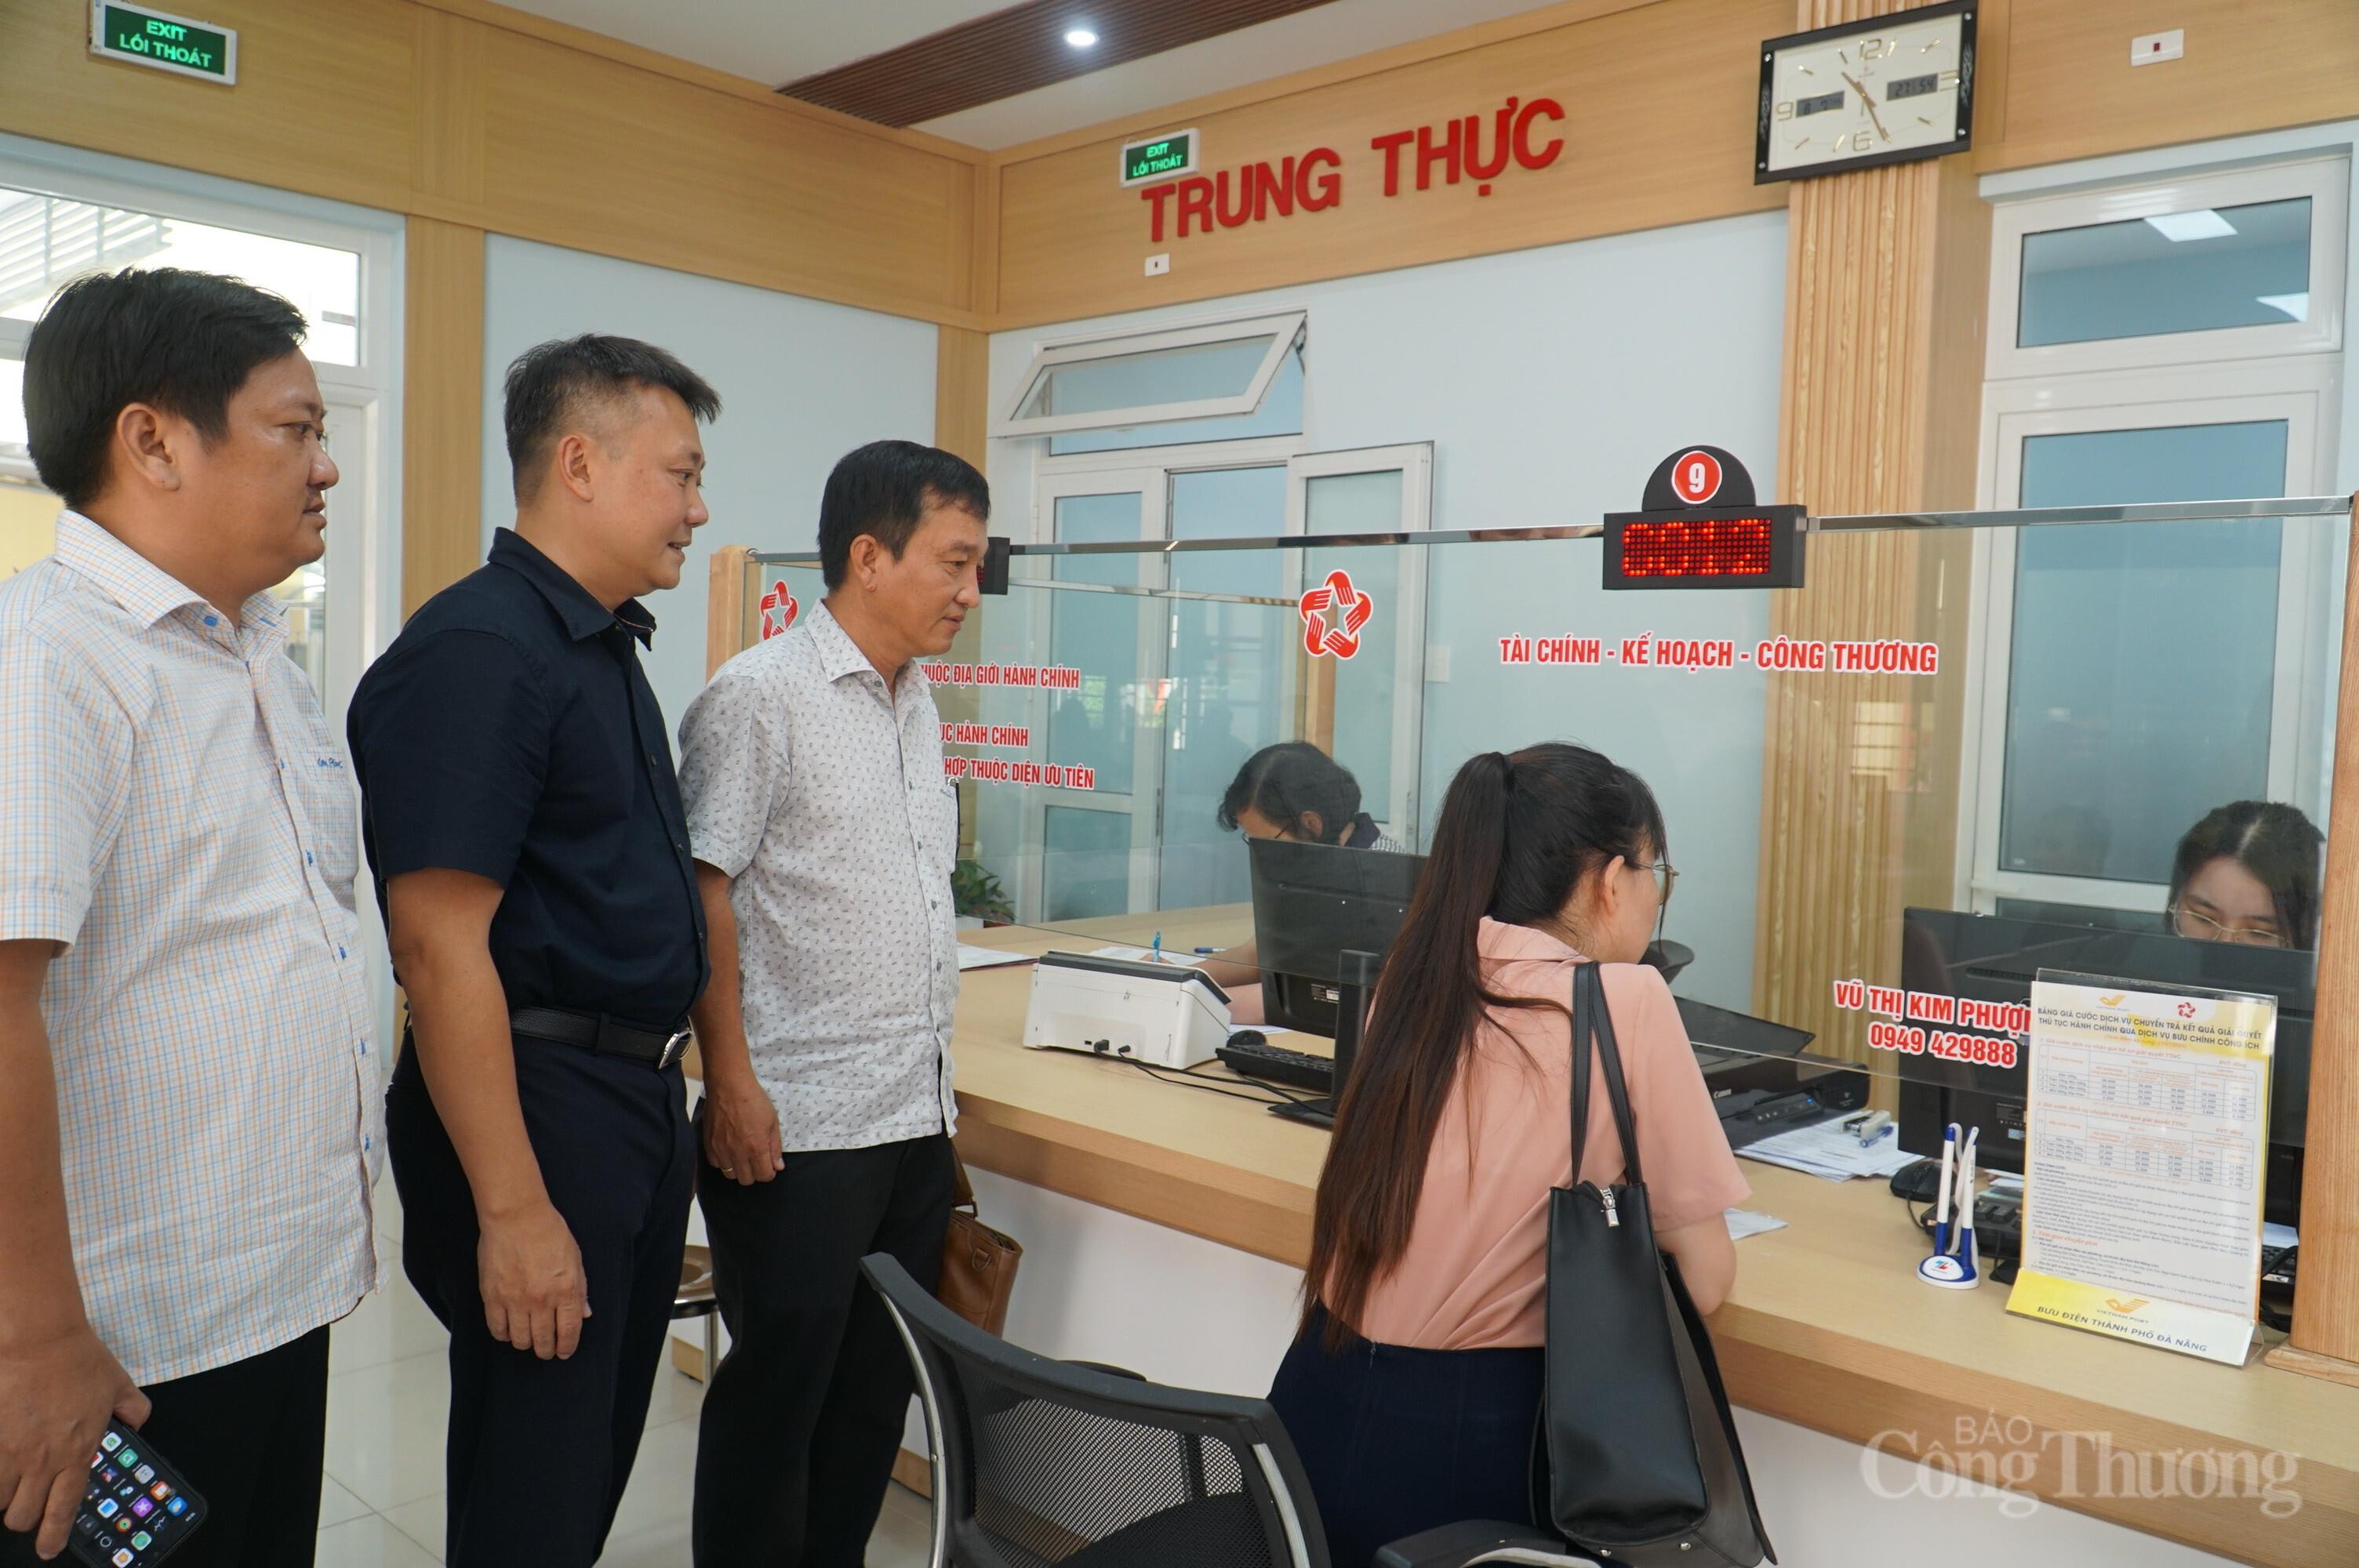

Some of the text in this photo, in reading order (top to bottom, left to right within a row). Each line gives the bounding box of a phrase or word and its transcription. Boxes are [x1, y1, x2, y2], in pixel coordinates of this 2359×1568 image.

[146, 20, 187, 42] EXIT
[119, 32, 212, 67] LỐI THOÁT
[1859, 38, 1882, 60] 12
[1775, 100, 1794, 122] 9
[1146, 142, 1169, 158] EXIT
[1852, 130, 1873, 152] 6
[1132, 153, 1183, 176] LỐI THOÁT
[1141, 96, 1565, 243] TRUNG THỰC
[1688, 462, 1706, 494] 9
[1500, 633, 1530, 662] TÀI
[1537, 633, 1601, 663] CHÍNH
[1623, 632, 1652, 665] KẾ
[1656, 640, 1733, 672] HOẠCH
[1757, 637, 1825, 669] CÔNG
[1834, 641, 1937, 673] THƯƠNG
[953, 665, 972, 687] ĐỊA
[976, 662, 999, 684] GIỚI
[1003, 662, 1036, 686] HÀNH
[1041, 665, 1080, 689] CHÍNH
[956, 720, 988, 744] HÀNH
[991, 723, 1029, 747] CHÍNH
[944, 757, 1094, 788] HỢP THUỘC DIỆN ƯU TIÊN
[1836, 982, 1863, 1007] VŨ
[1870, 988, 1903, 1019] THỊ
[1909, 994, 1953, 1022] KIM
[1870, 1023, 2016, 1066] 0949 429888
[2119, 1026, 2136, 1036] QUA
[2037, 1305, 2059, 1316] BƯU
[2061, 1312, 2088, 1323] ĐIỆN
[2092, 1318, 2128, 1333] THÀNH
[2131, 1327, 2154, 1339] PHỐ
[2157, 1333, 2172, 1344] ĐÀ
